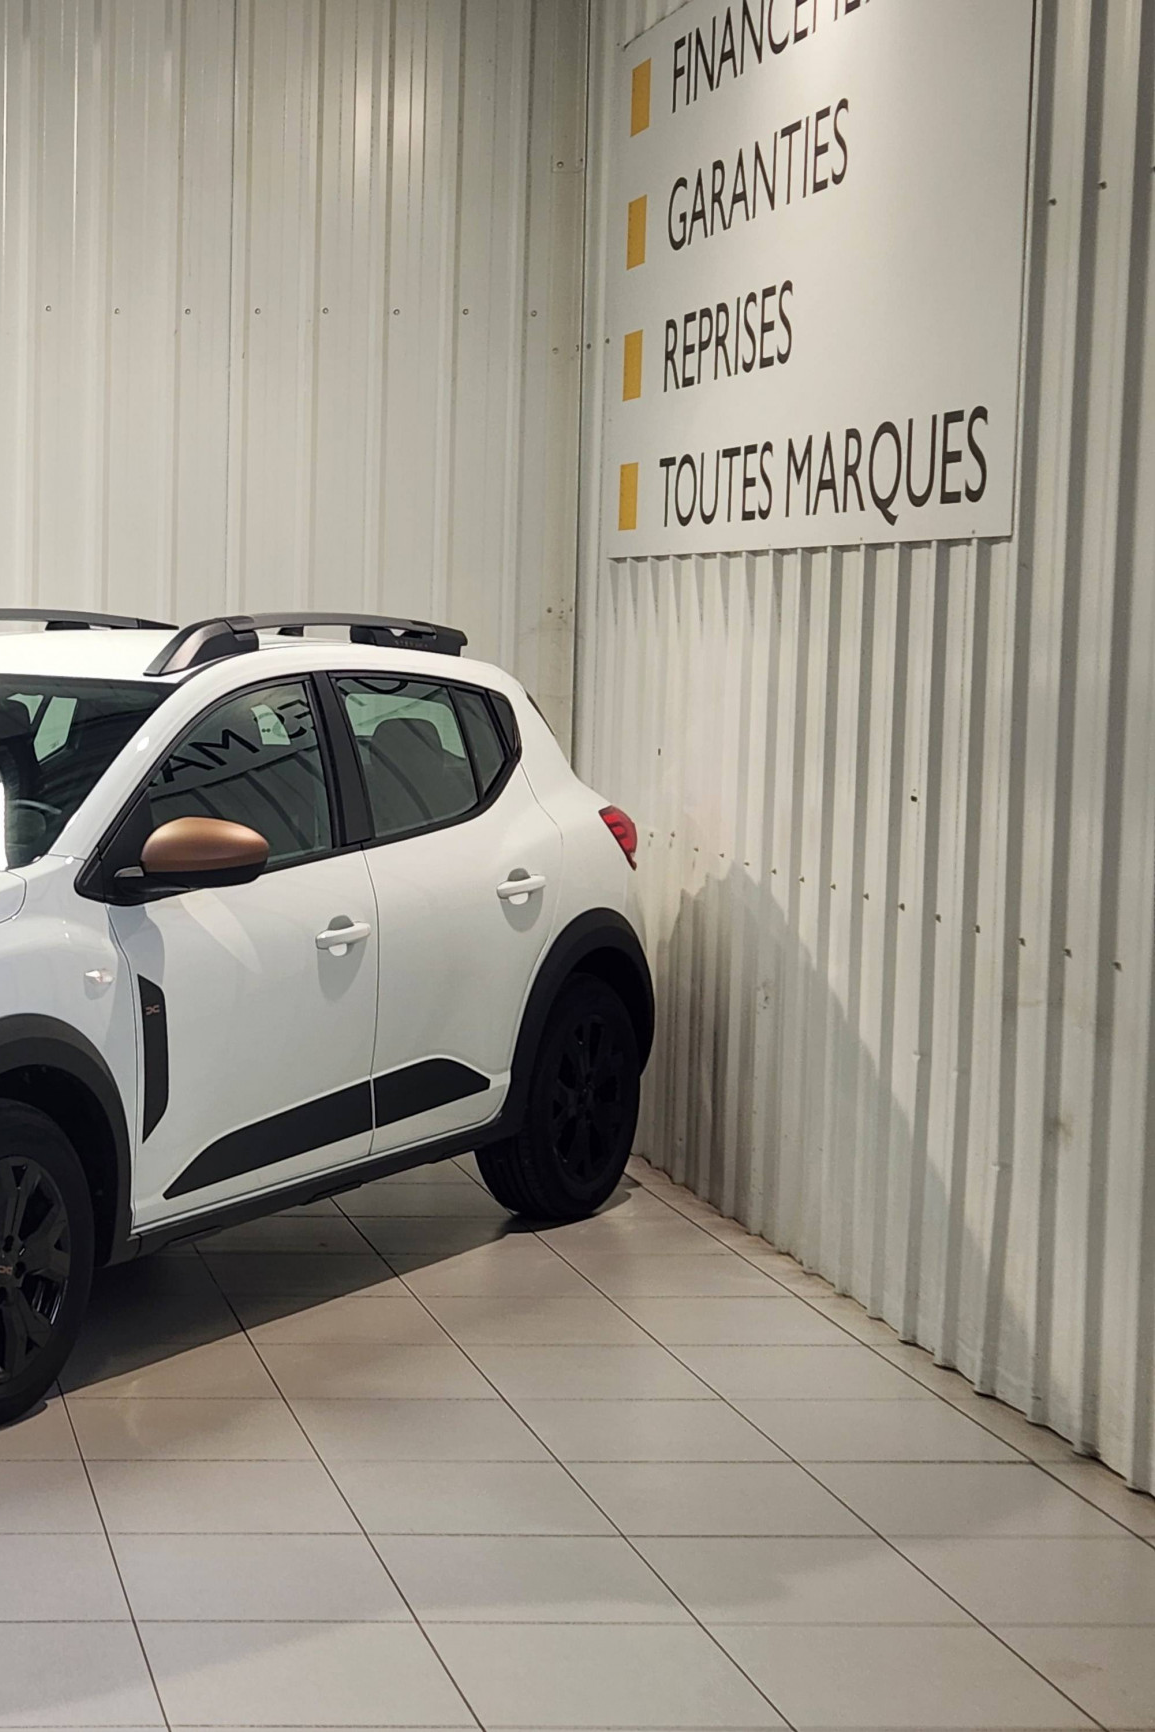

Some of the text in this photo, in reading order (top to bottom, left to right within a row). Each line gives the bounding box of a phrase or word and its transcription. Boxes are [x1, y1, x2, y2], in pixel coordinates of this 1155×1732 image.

[672, 0, 870, 113] FINANCE
[668, 98, 849, 251] GARANTIES
[663, 280, 794, 392] REPRISES
[659, 405, 988, 527] TOUTES MARQUES
